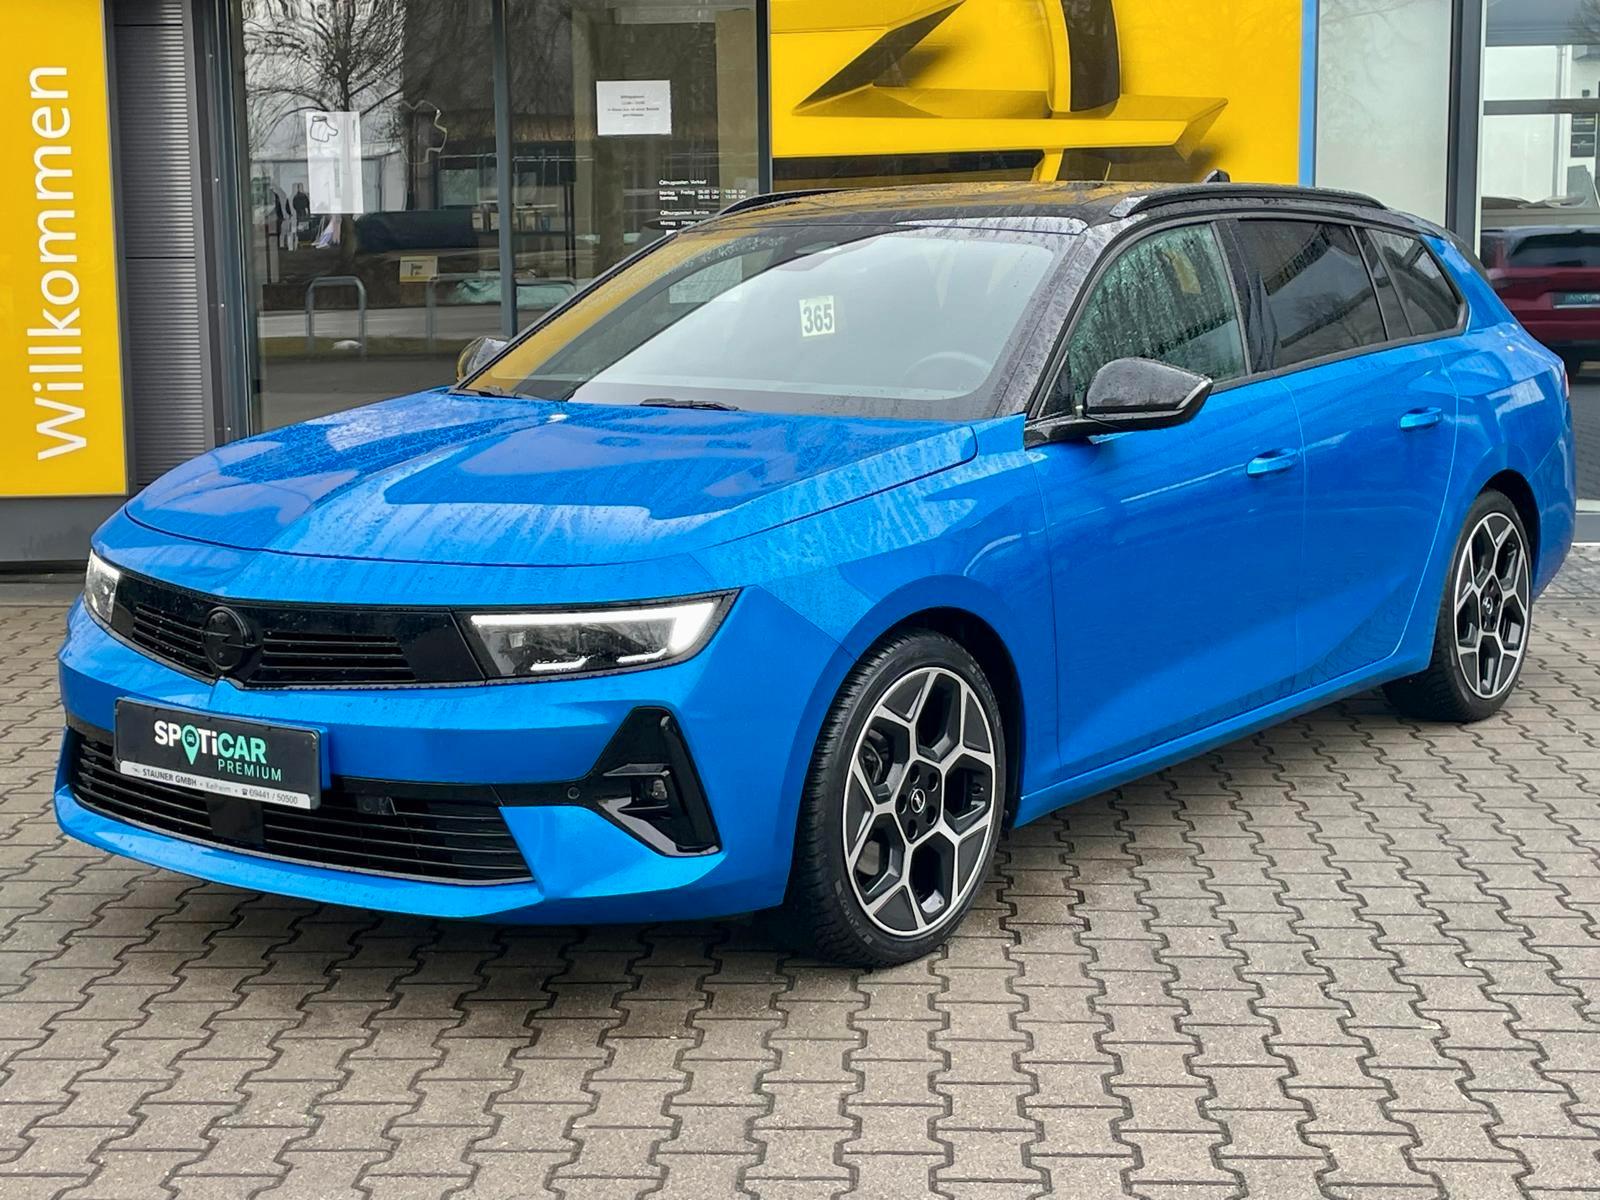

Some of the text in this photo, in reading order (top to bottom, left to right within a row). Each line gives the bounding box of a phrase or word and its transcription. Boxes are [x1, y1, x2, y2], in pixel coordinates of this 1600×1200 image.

[27, 67, 87, 461] Willkommen
[803, 303, 833, 334] 365
[142, 767, 174, 782] STAUNER
[175, 774, 197, 786] GMBH
[218, 758, 282, 782] PREMIUM
